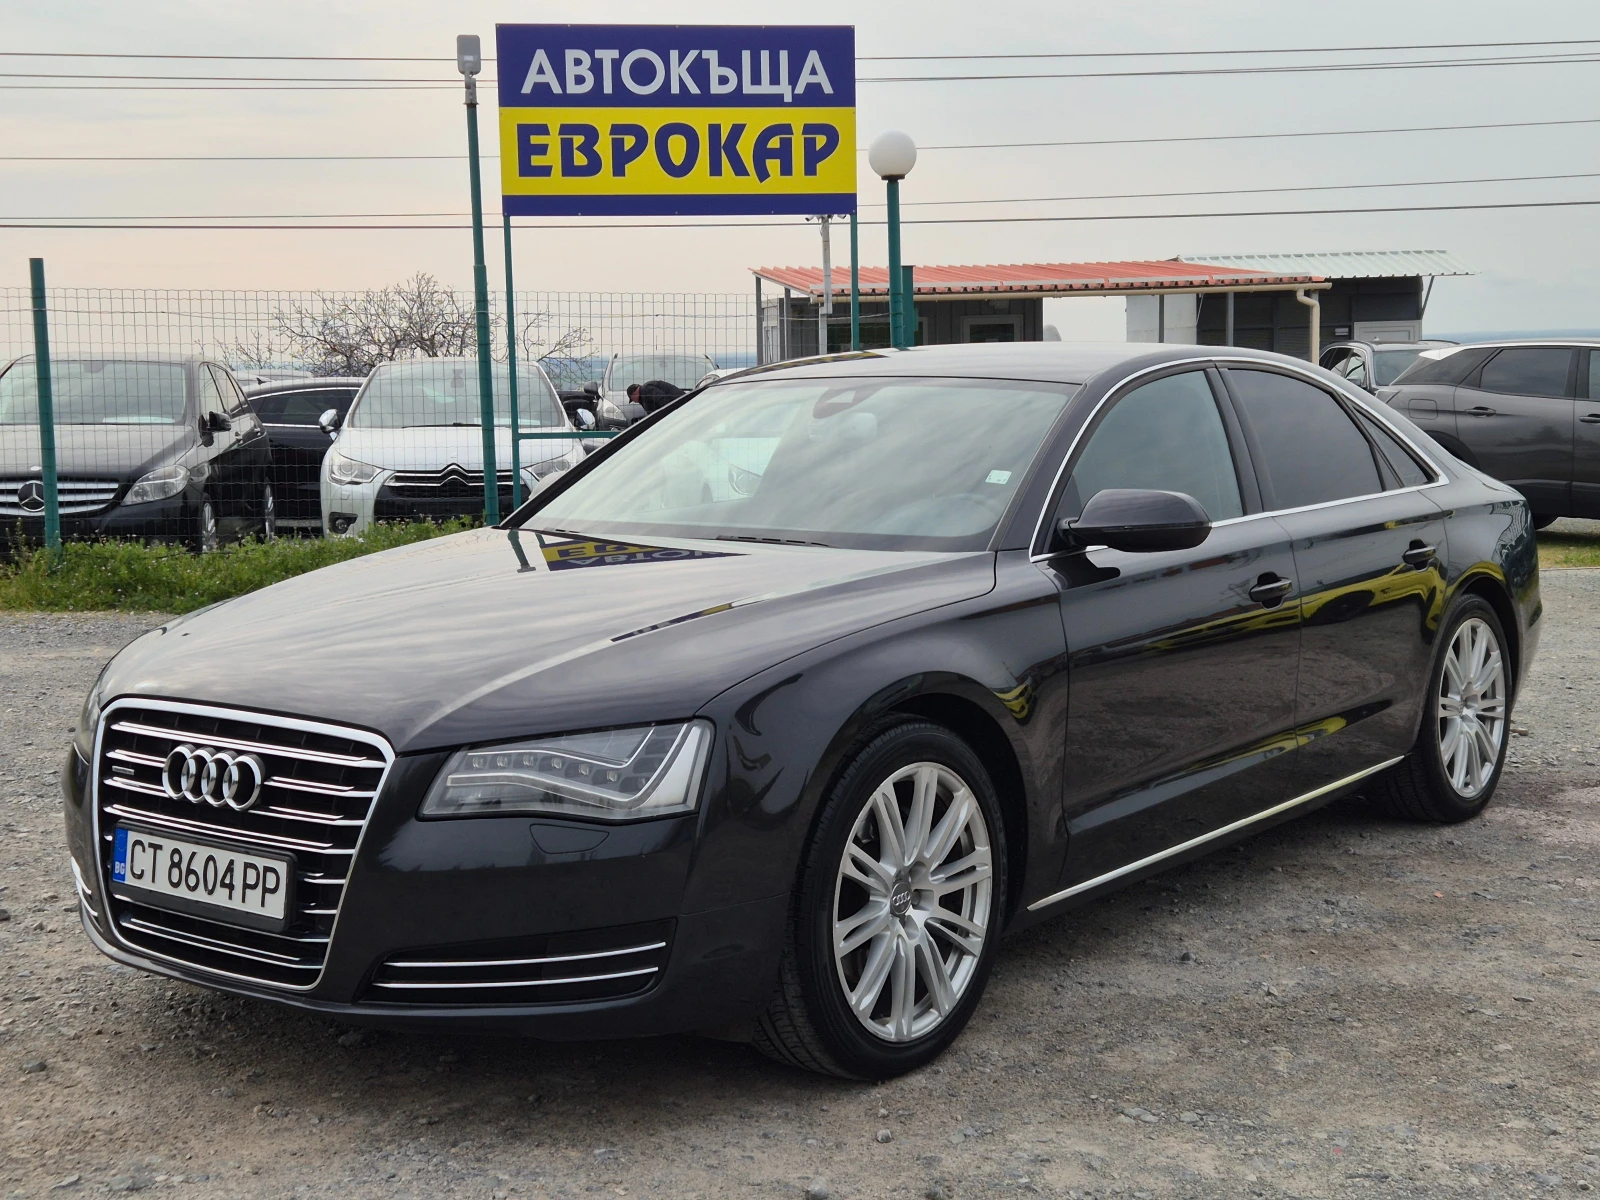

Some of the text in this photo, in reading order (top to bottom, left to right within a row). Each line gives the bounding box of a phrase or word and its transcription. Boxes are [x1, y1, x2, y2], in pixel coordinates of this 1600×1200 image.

[521, 49, 834, 103] АВТОКЪЩА
[516, 122, 840, 183] ЕВРОКАР
[115, 861, 125, 875] BG
